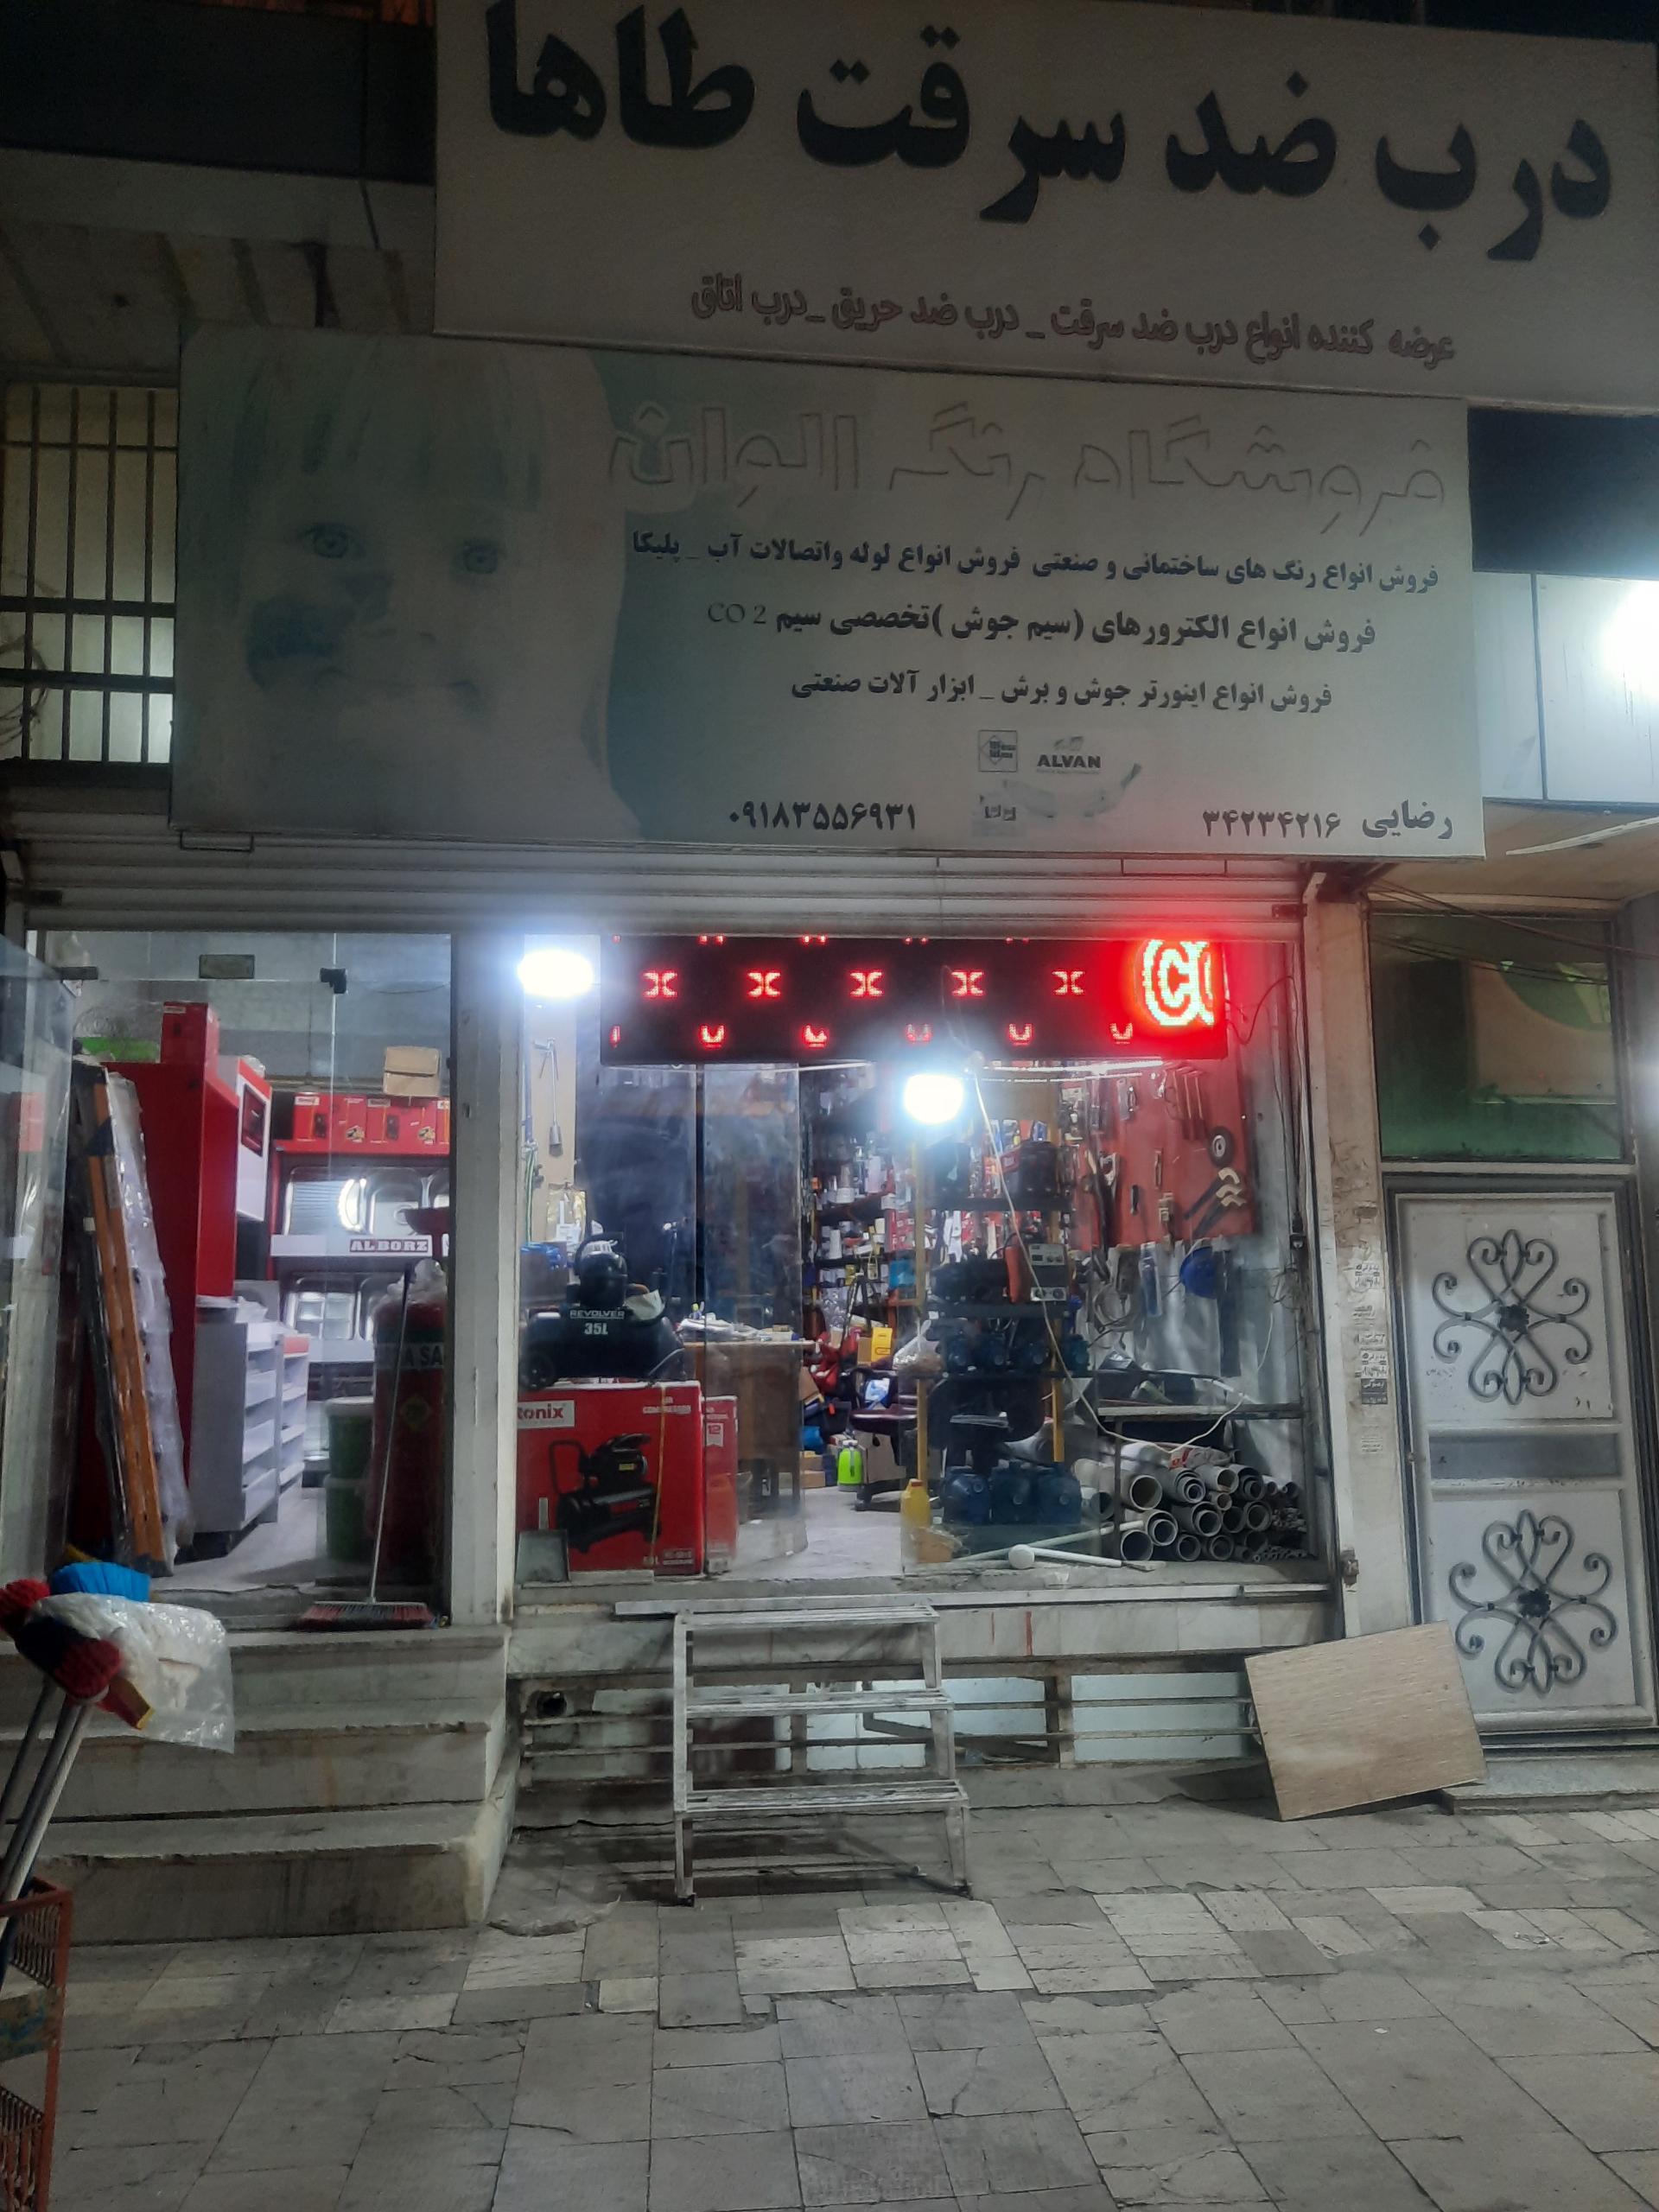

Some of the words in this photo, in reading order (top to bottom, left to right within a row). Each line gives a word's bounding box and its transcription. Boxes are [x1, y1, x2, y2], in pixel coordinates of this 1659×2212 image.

[484, 0, 756, 150] طاها
[795, 22, 1127, 224] سرقت
[1166, 70, 1338, 198] ضد
[1375, 118, 1612, 263] درب
[691, 271, 742, 319] اتاق
[751, 288, 807, 325] درب
[831, 287, 902, 331] حریق
[910, 291, 957, 325] ضد
[964, 303, 1018, 338] درب
[1050, 298, 1123, 349] سرقت
[1132, 308, 1178, 342] ضد
[1185, 317, 1237, 355] درب
[1245, 308, 1300, 364] انواع
[1307, 319, 1375, 354] کننده
[1389, 324, 1456, 370] عرضه
[632, 531, 680, 564] پلیکا
[708, 533, 742, 558] آب
[850, 543, 891, 569] لوله
[899, 545, 951, 572] انواع
[957, 546, 1020, 576] فروش
[1032, 552, 1098, 577] صنعتی
[1106, 563, 1116, 579] و
[1123, 552, 1219, 581] ساختمانی
[1226, 556, 1266, 584] های
[1274, 559, 1316, 589] رنگ
[1324, 562, 1372, 589] انواع
[1380, 565, 1438, 594] فروش
[776, 607, 821, 632] سیم
[1236, 615, 1297, 649] انواع
[1304, 619, 1376, 652] فروش
[791, 673, 861, 697] صنعتی
[868, 670, 921, 694] آلات
[926, 671, 975, 702] ابزار
[1001, 674, 1050, 704] برش
[1055, 688, 1067, 705] و
[1074, 677, 1131, 705] جوش
[1137, 679, 1206, 708] اینورتر
[1212, 681, 1265, 709] انواع
[1270, 683, 1332, 713] فروش
[1037, 754, 1102, 768] ALVAN
[730, 801, 915, 830] ۰۹۱۸۳۵۵۶۹۳۱
[1362, 800, 1453, 839] رضایی
[350, 1239, 429, 1252] ALBORZ
[569, 1309, 625, 1319] REVOLVER
[584, 1322, 608, 1336] 35L
